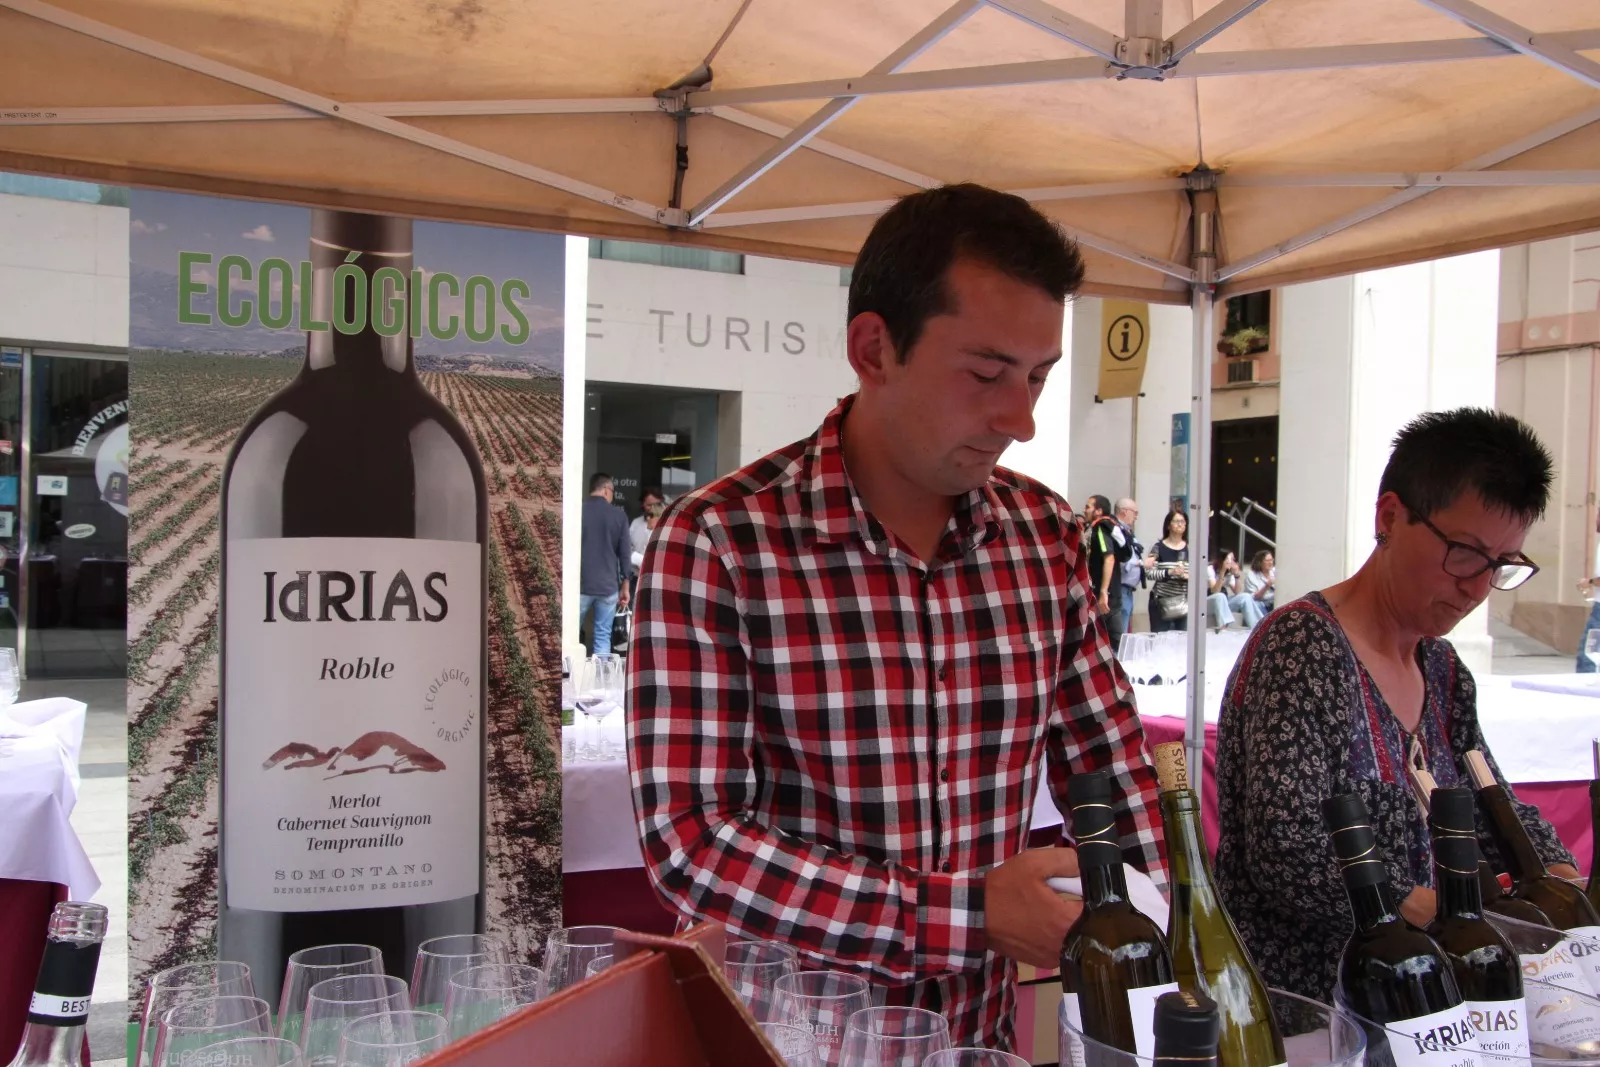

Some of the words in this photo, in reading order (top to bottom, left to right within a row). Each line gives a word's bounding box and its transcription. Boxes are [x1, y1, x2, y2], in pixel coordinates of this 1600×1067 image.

[177, 250, 532, 346] ECOLÓGICOS
[620, 477, 638, 487] otra
[318, 657, 395, 681] Roble
[424, 668, 470, 711] ECOLÓGICO
[437, 709, 475, 743] ORGANIC
[328, 793, 382, 810] Merlot
[277, 814, 348, 832] Cabernet
[350, 812, 433, 830] Sauvignon
[305, 833, 405, 852] Tempranillo
[274, 862, 433, 882] SOMONTANO
[273, 883, 365, 895] DENOMINACIÓN
[371, 882, 387, 891] DE
[391, 879, 434, 889] ORIGEN
